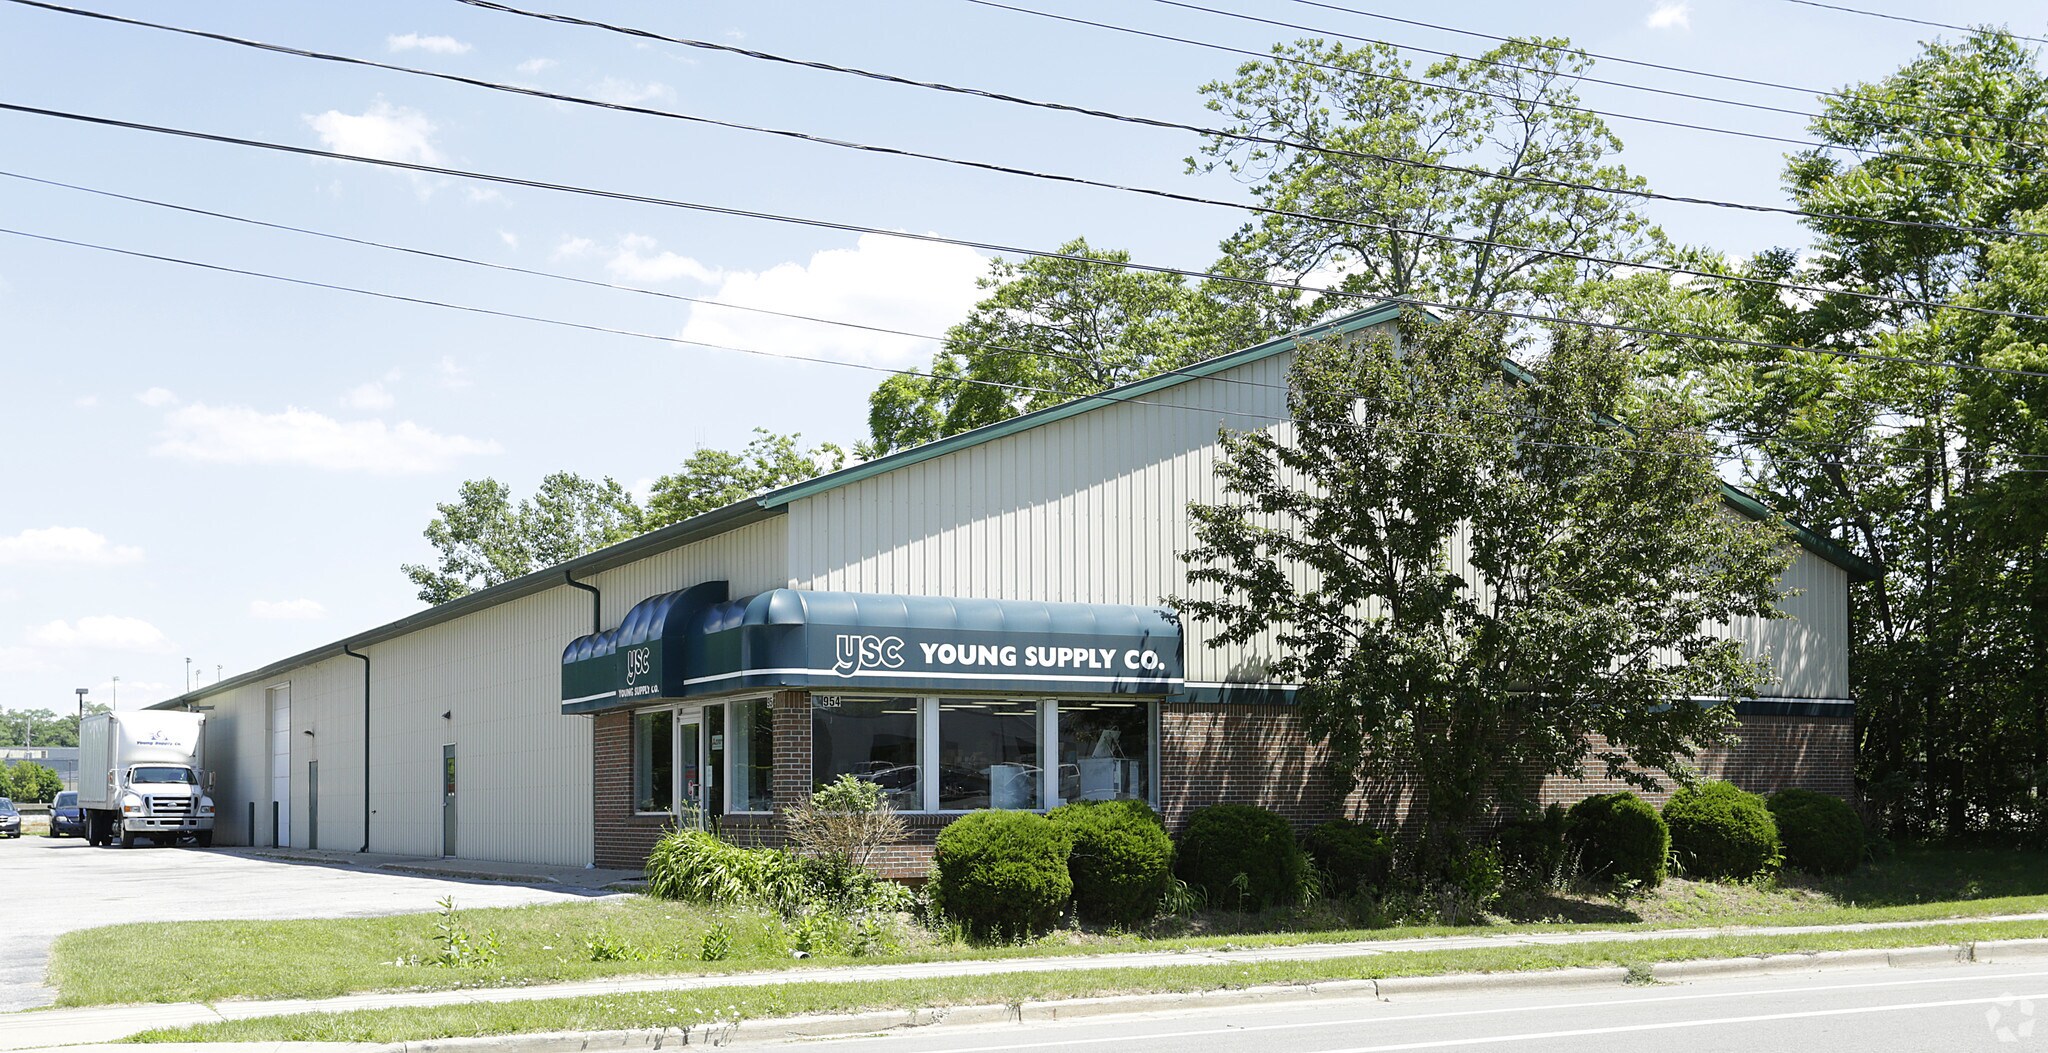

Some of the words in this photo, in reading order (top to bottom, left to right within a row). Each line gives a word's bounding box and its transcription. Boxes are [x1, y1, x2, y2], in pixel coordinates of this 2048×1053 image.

[919, 643, 1017, 667] YOUNG
[1024, 646, 1117, 669] SUPPLY
[1124, 649, 1166, 671] CO.
[618, 687, 634, 698] YOUNG
[634, 685, 650, 696] SUPPLY
[650, 684, 660, 694] CO.
[823, 696, 841, 707] 954
